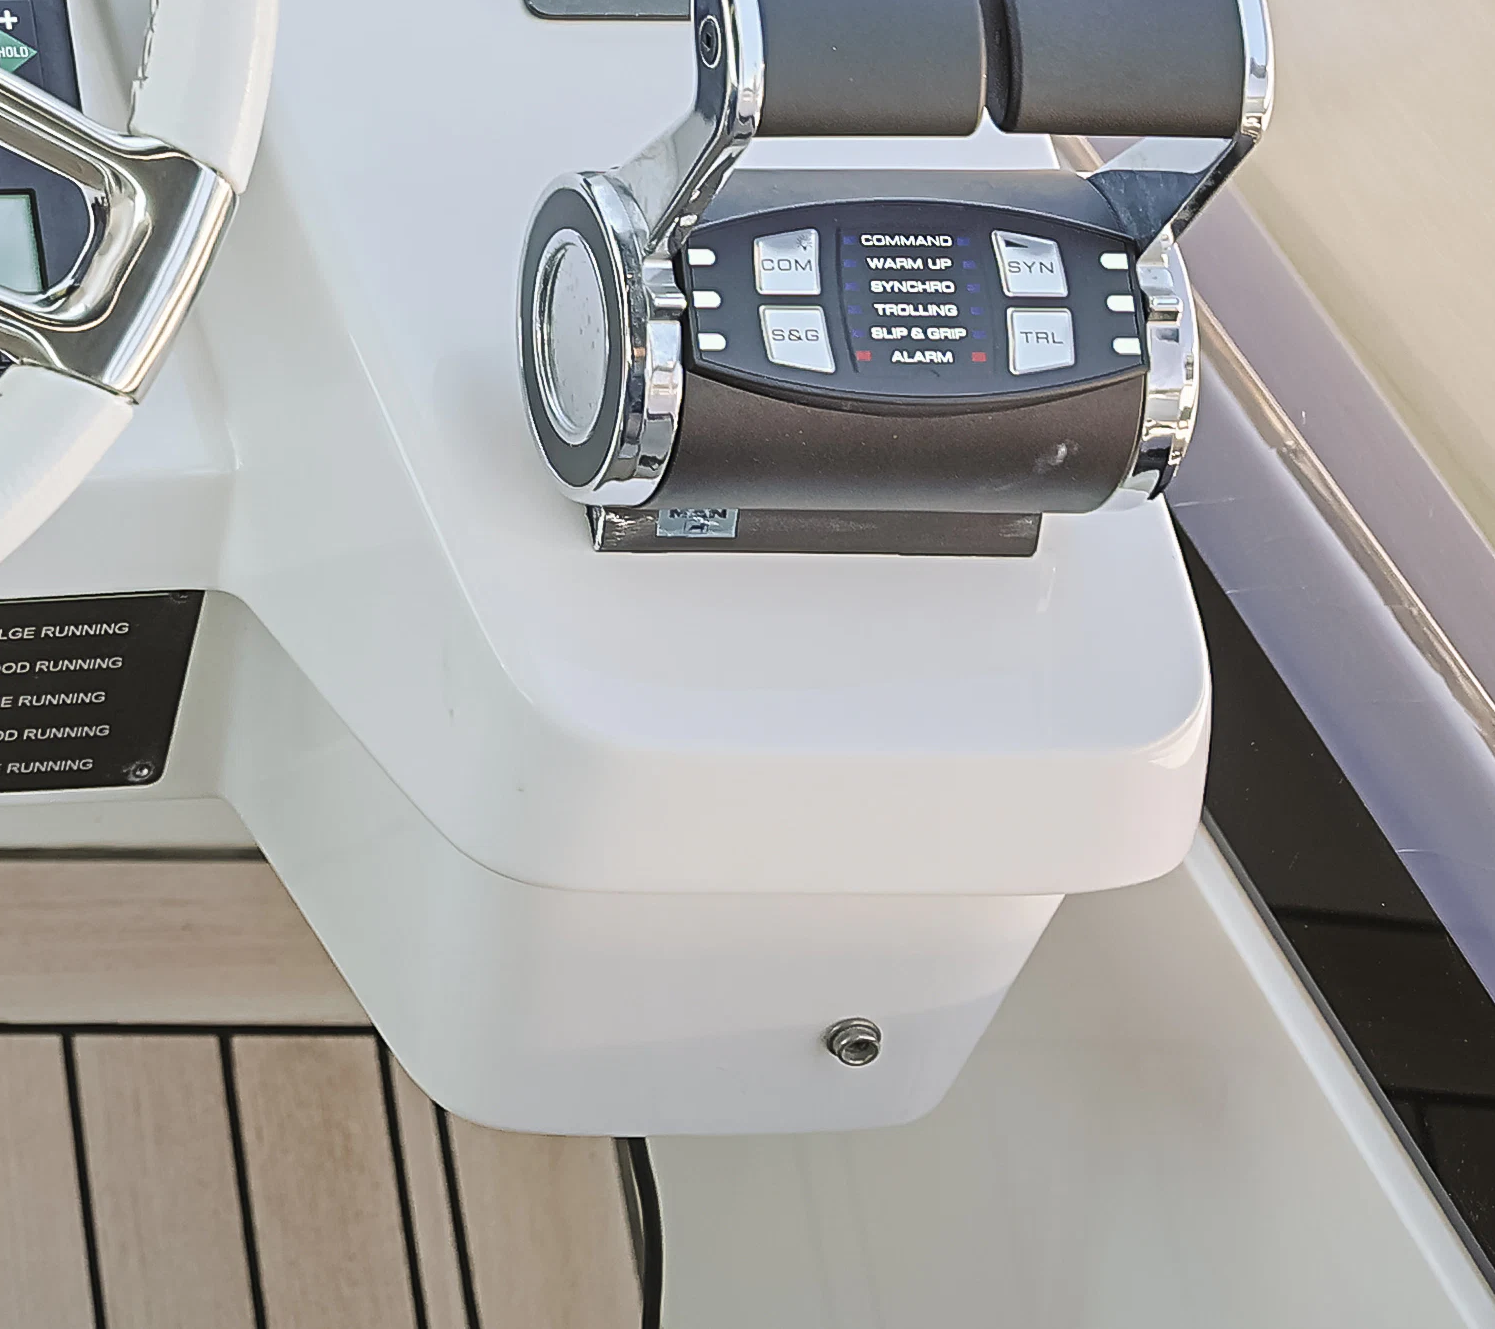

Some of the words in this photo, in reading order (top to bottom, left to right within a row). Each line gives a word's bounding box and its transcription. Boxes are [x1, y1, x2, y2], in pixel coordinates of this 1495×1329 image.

[860, 234, 953, 247] COMMAND
[762, 257, 814, 273] COM
[866, 258, 923, 269] WARM
[928, 258, 952, 269] UP
[1007, 259, 1055, 276] SYN
[870, 281, 955, 293] SYNCHRO
[874, 304, 958, 316] TROLLING
[771, 327, 820, 343] S&G
[871, 327, 908, 339] SLIP
[910, 327, 925, 339] &
[927, 327, 967, 340] GRIP
[1019, 329, 1064, 346] TRL
[891, 350, 954, 363] ALARM
[41, 622, 129, 639] RUNNING
[36, 657, 123, 672] RUNNING
[18, 691, 106, 707] RUNNING
[23, 725, 110, 740] RUNNING
[7, 759, 93, 774] RUNNING
